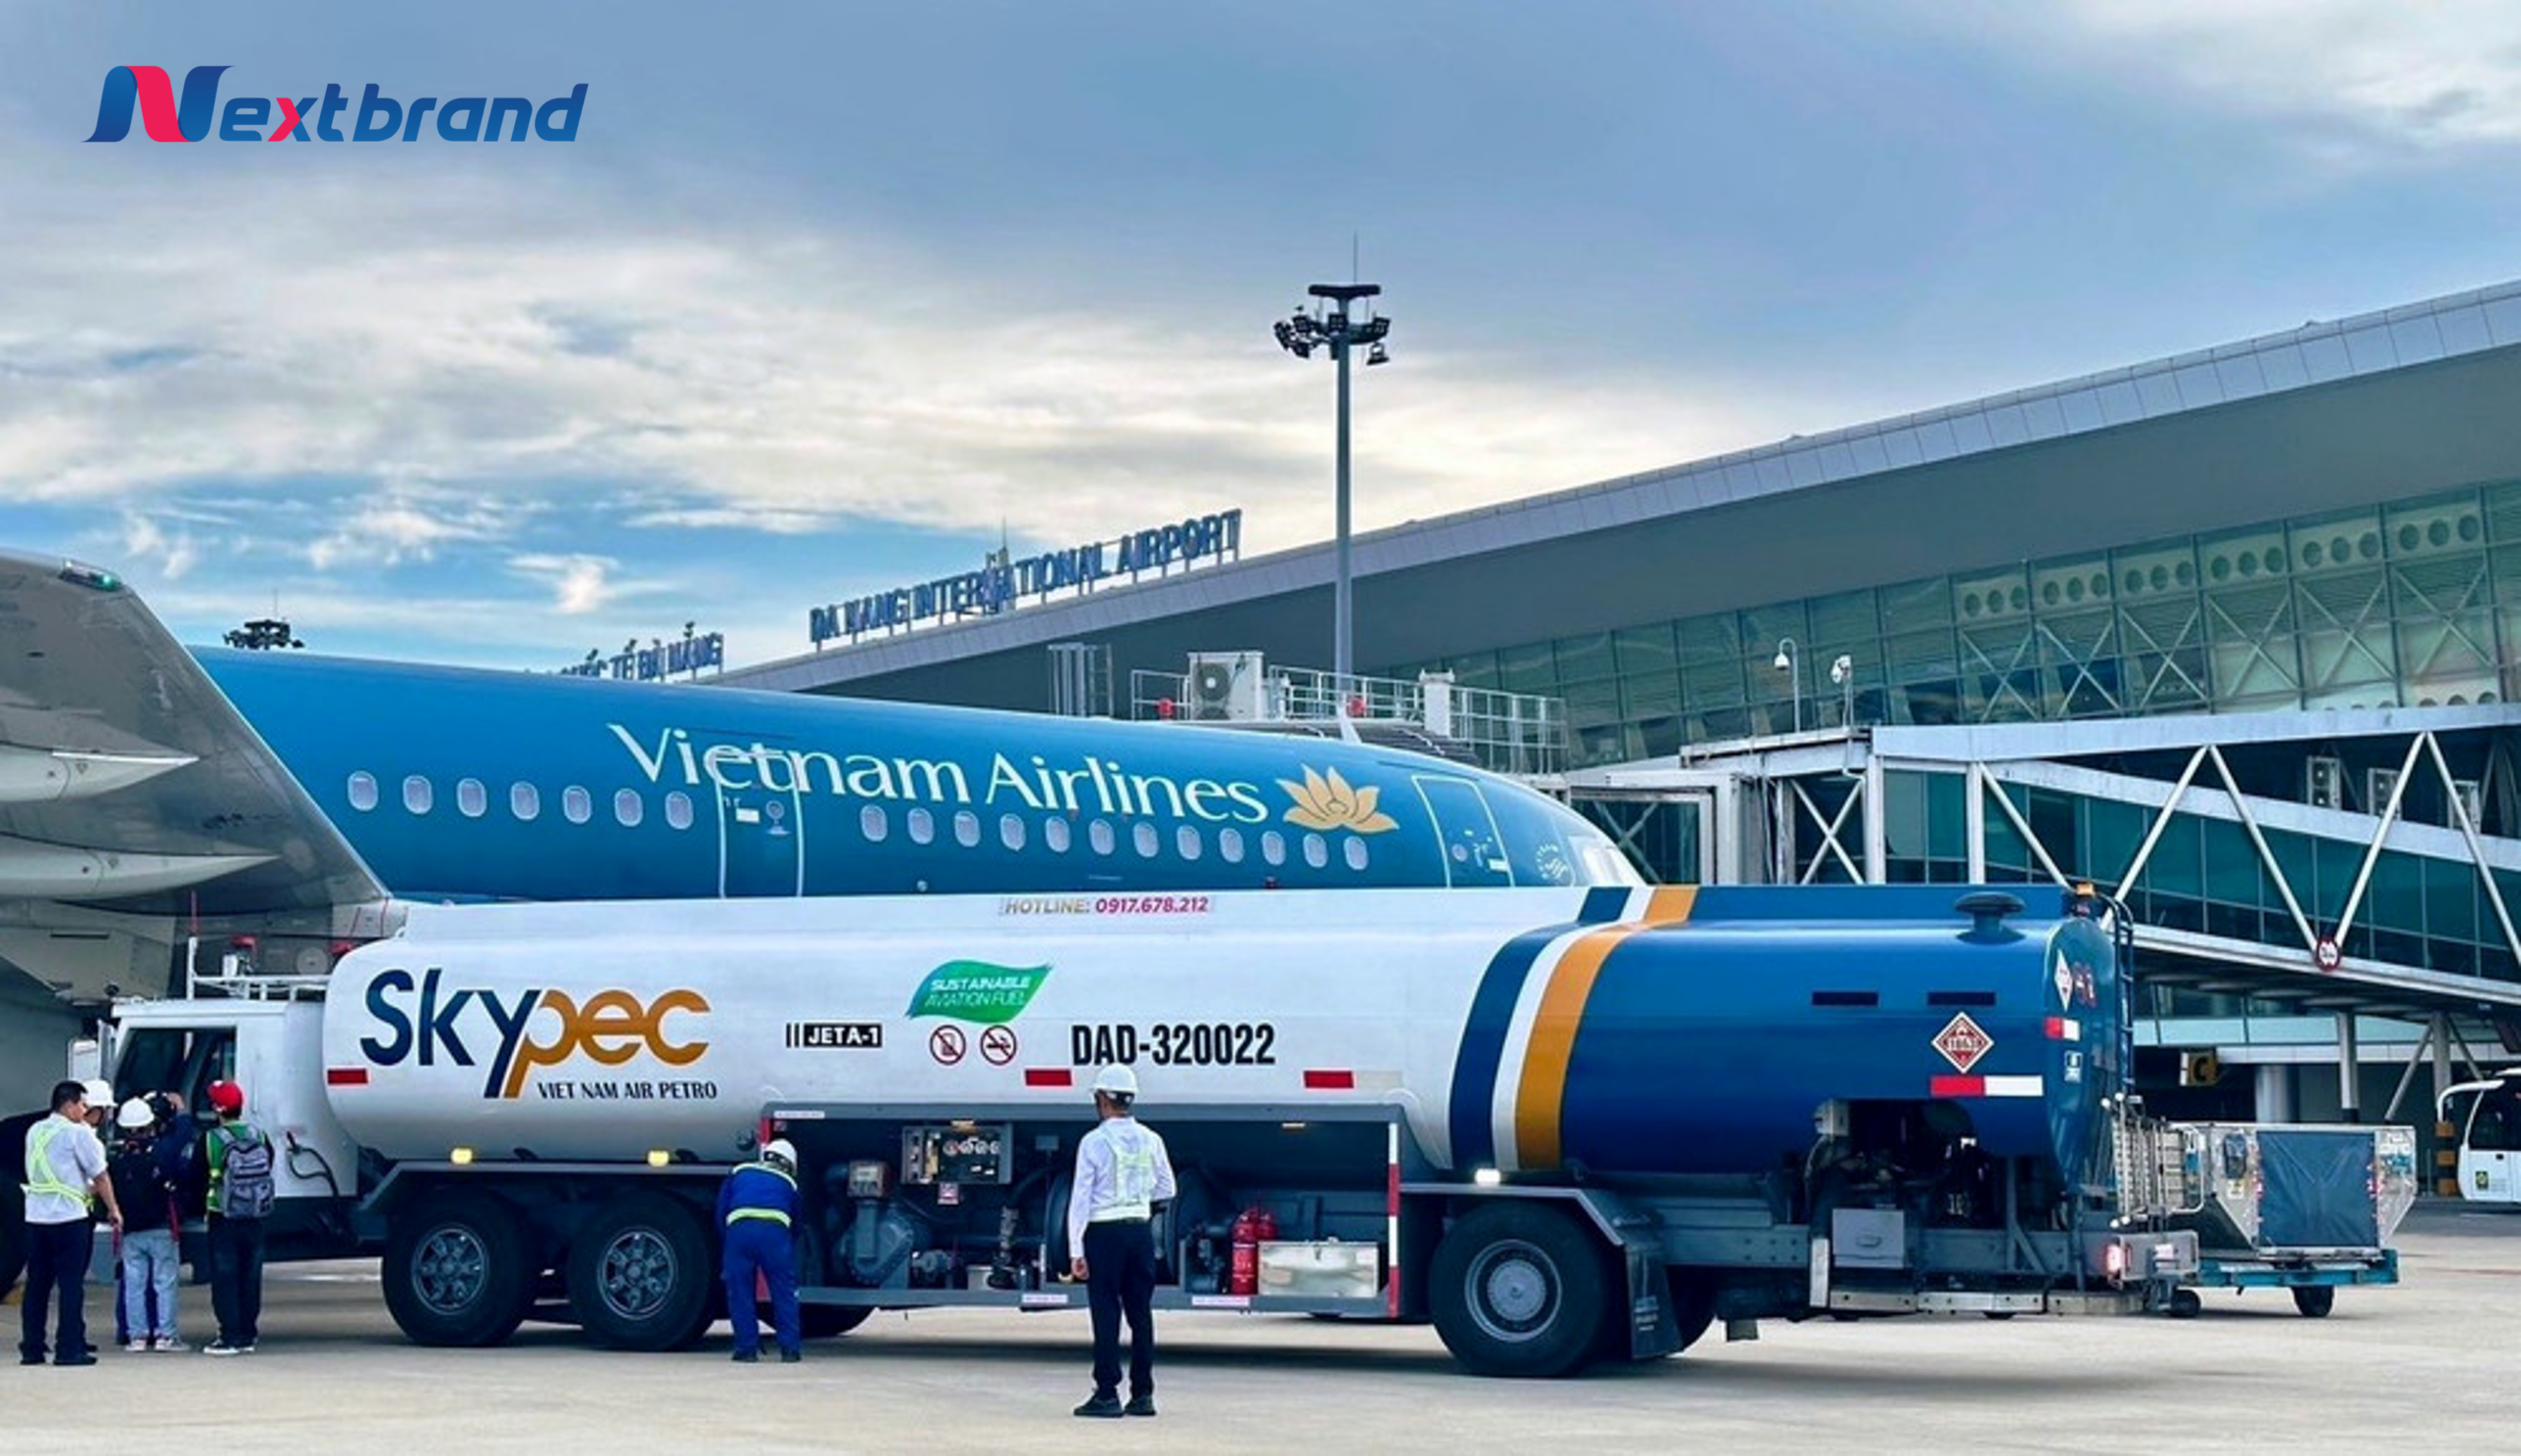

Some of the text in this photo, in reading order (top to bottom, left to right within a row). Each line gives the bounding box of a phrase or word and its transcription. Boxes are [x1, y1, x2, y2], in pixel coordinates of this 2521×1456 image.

[1116, 508, 1241, 575] AIRPORT
[607, 725, 1268, 822] Vietnam Airlines
[1004, 896, 1208, 915] HOTLINE: 0917.678.212
[931, 976, 1031, 991] SUSTAINABLE
[924, 990, 1024, 1008] AVIATION FUEL
[359, 969, 711, 1099] Skypec
[808, 1026, 879, 1045] JETA-1
[1071, 1023, 1276, 1066] DAD-320022
[537, 1082, 718, 1100] VIET NAM AIR PETRO
